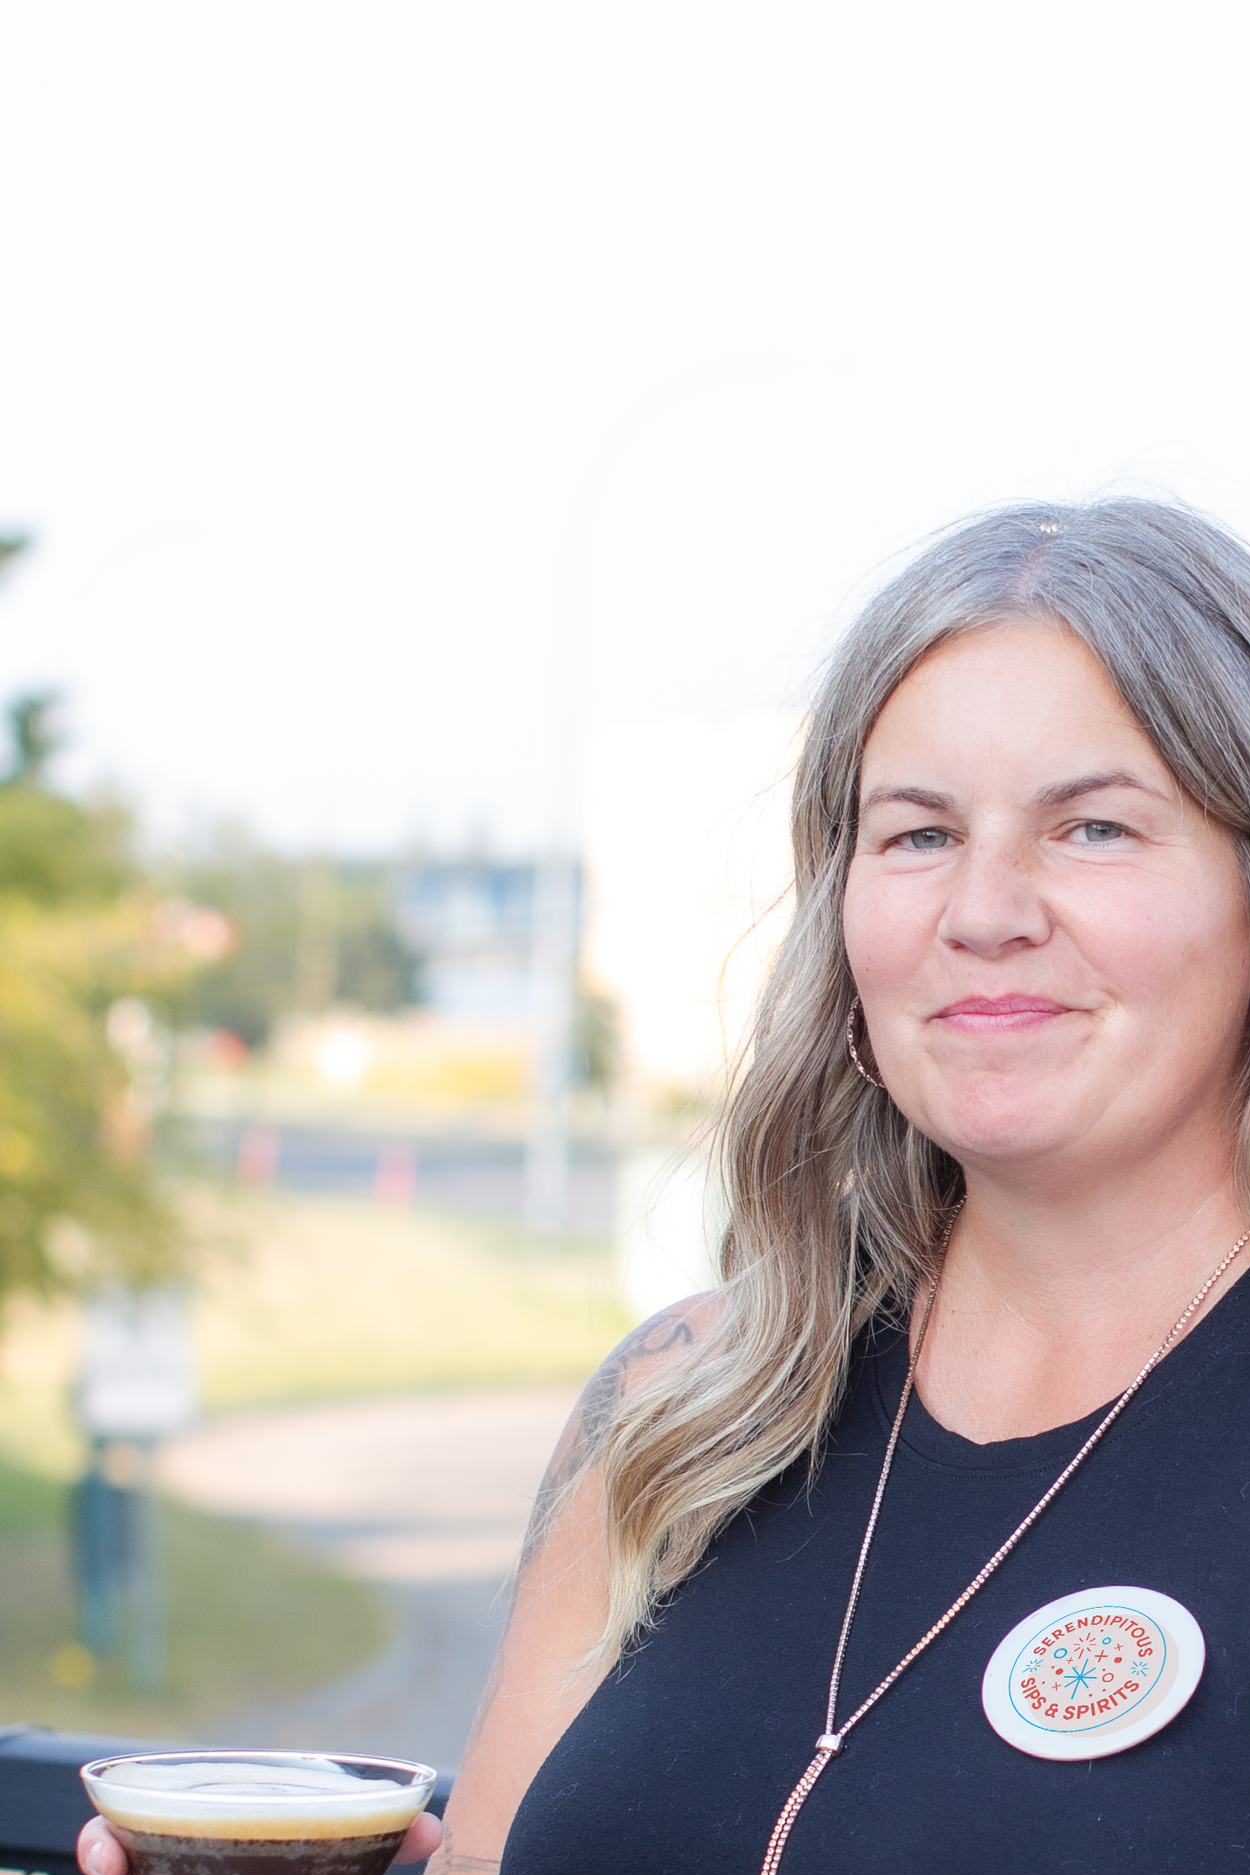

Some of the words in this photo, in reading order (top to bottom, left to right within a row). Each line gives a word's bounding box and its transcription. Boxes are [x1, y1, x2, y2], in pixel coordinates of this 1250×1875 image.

[1033, 1614, 1153, 1657] SERENDIPITOUS
[1020, 1677, 1047, 1710] SIPS
[1044, 1703, 1059, 1718] &
[1062, 1680, 1140, 1720] SPIRITS
